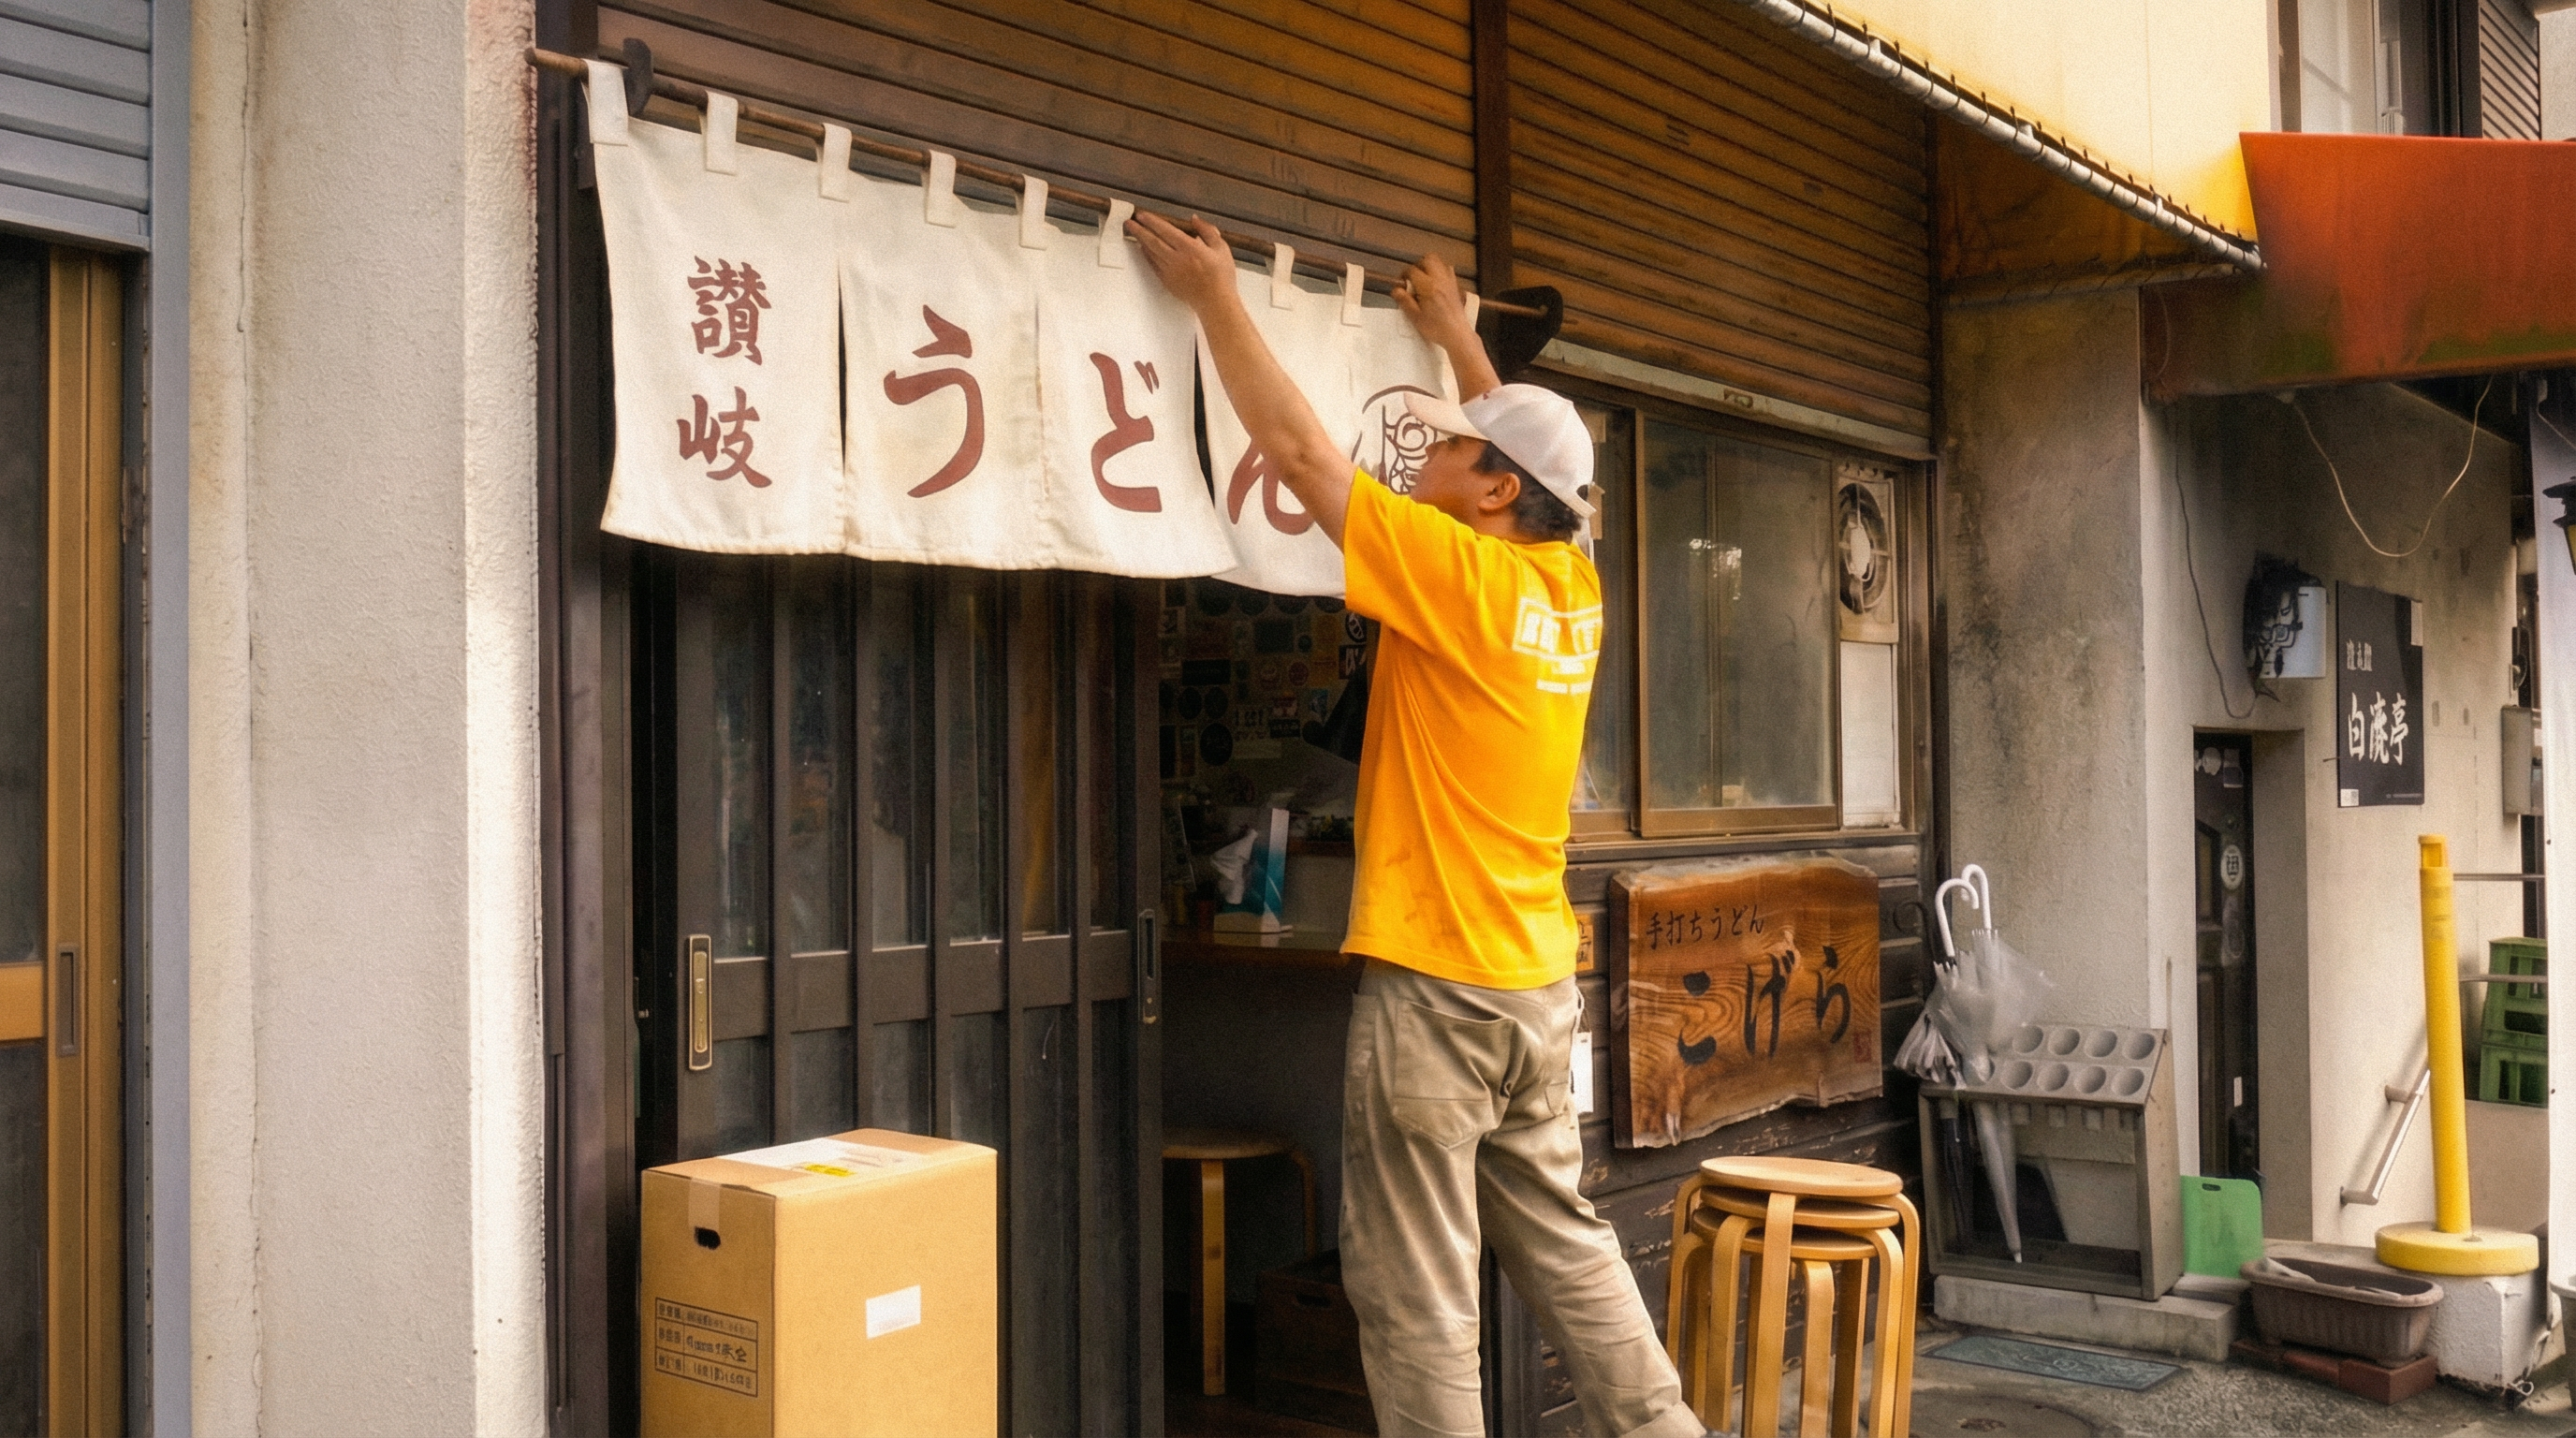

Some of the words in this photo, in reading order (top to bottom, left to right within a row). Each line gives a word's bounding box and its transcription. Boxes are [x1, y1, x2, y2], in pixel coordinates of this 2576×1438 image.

[676, 254, 773, 489] 讃岐
[1645, 904, 1765, 950] 手打ちうどん
[1677, 945, 1852, 1066] こげら
